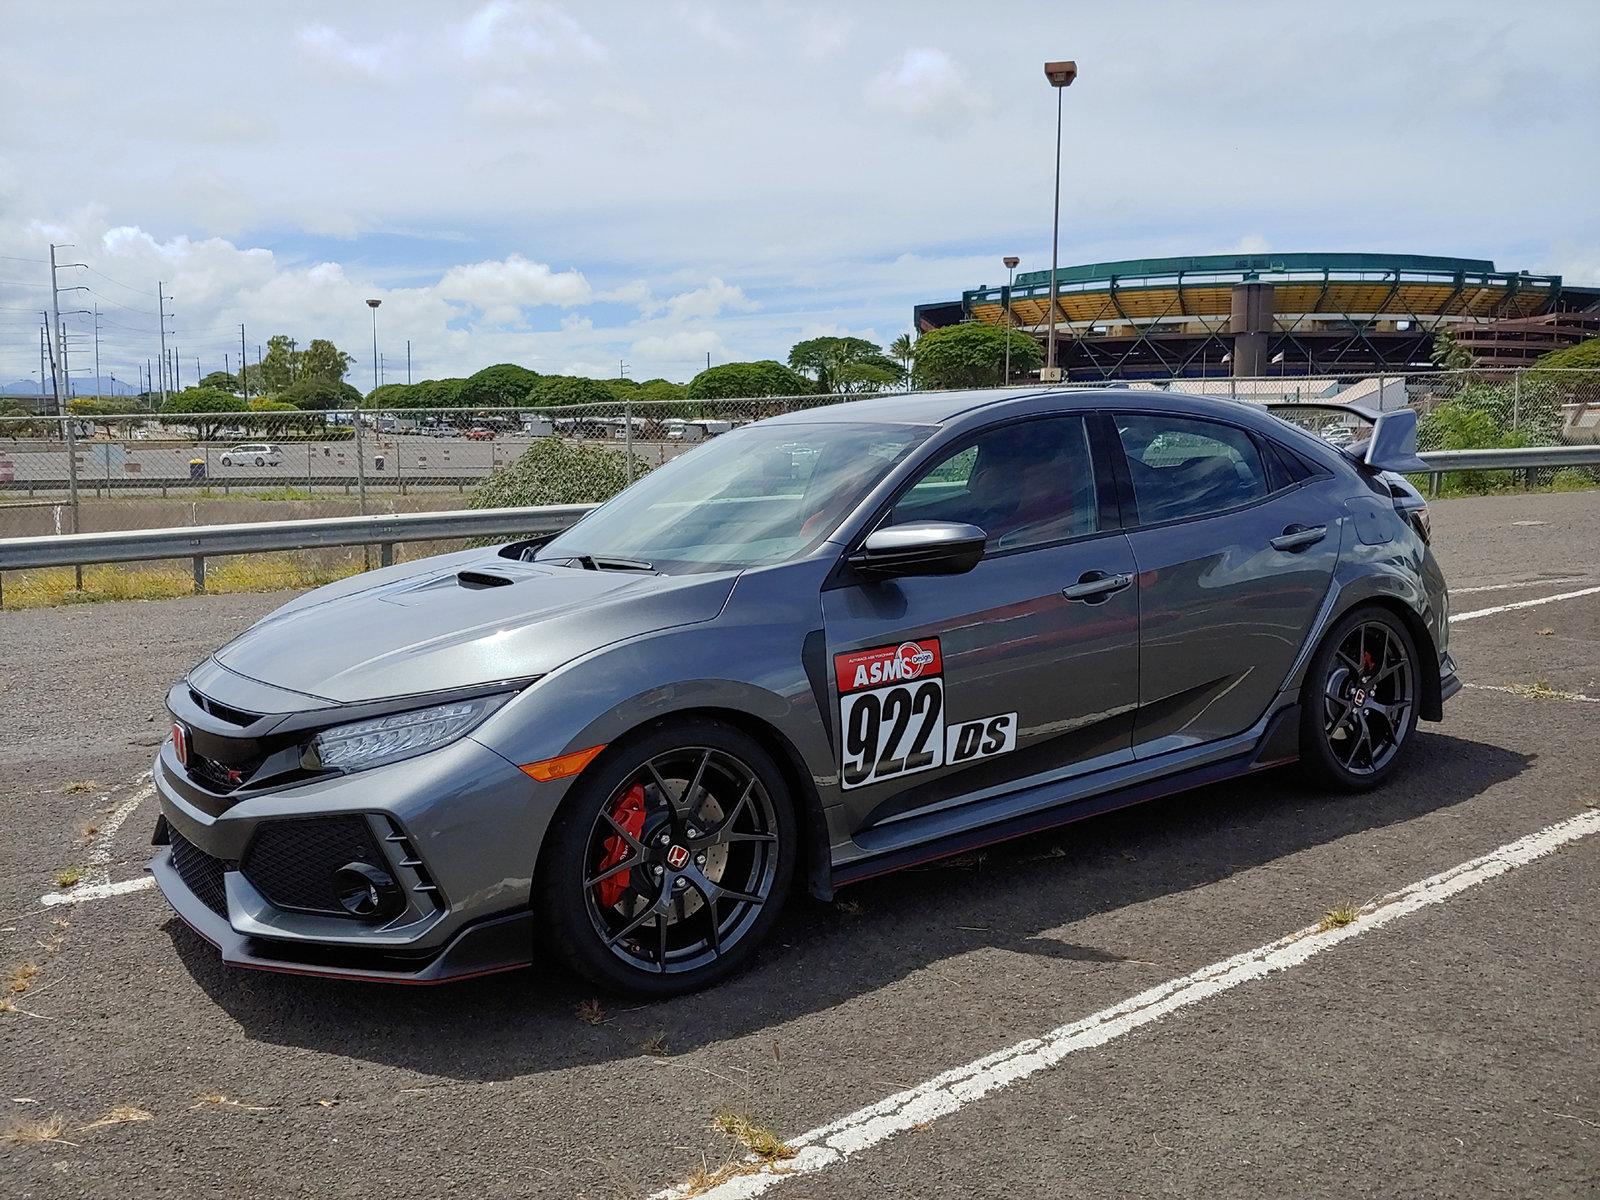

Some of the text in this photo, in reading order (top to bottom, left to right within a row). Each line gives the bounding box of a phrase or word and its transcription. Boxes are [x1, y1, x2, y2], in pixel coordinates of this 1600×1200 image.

[913, 653, 932, 664] Design
[844, 682, 942, 785] 922
[953, 716, 1010, 761] DS
